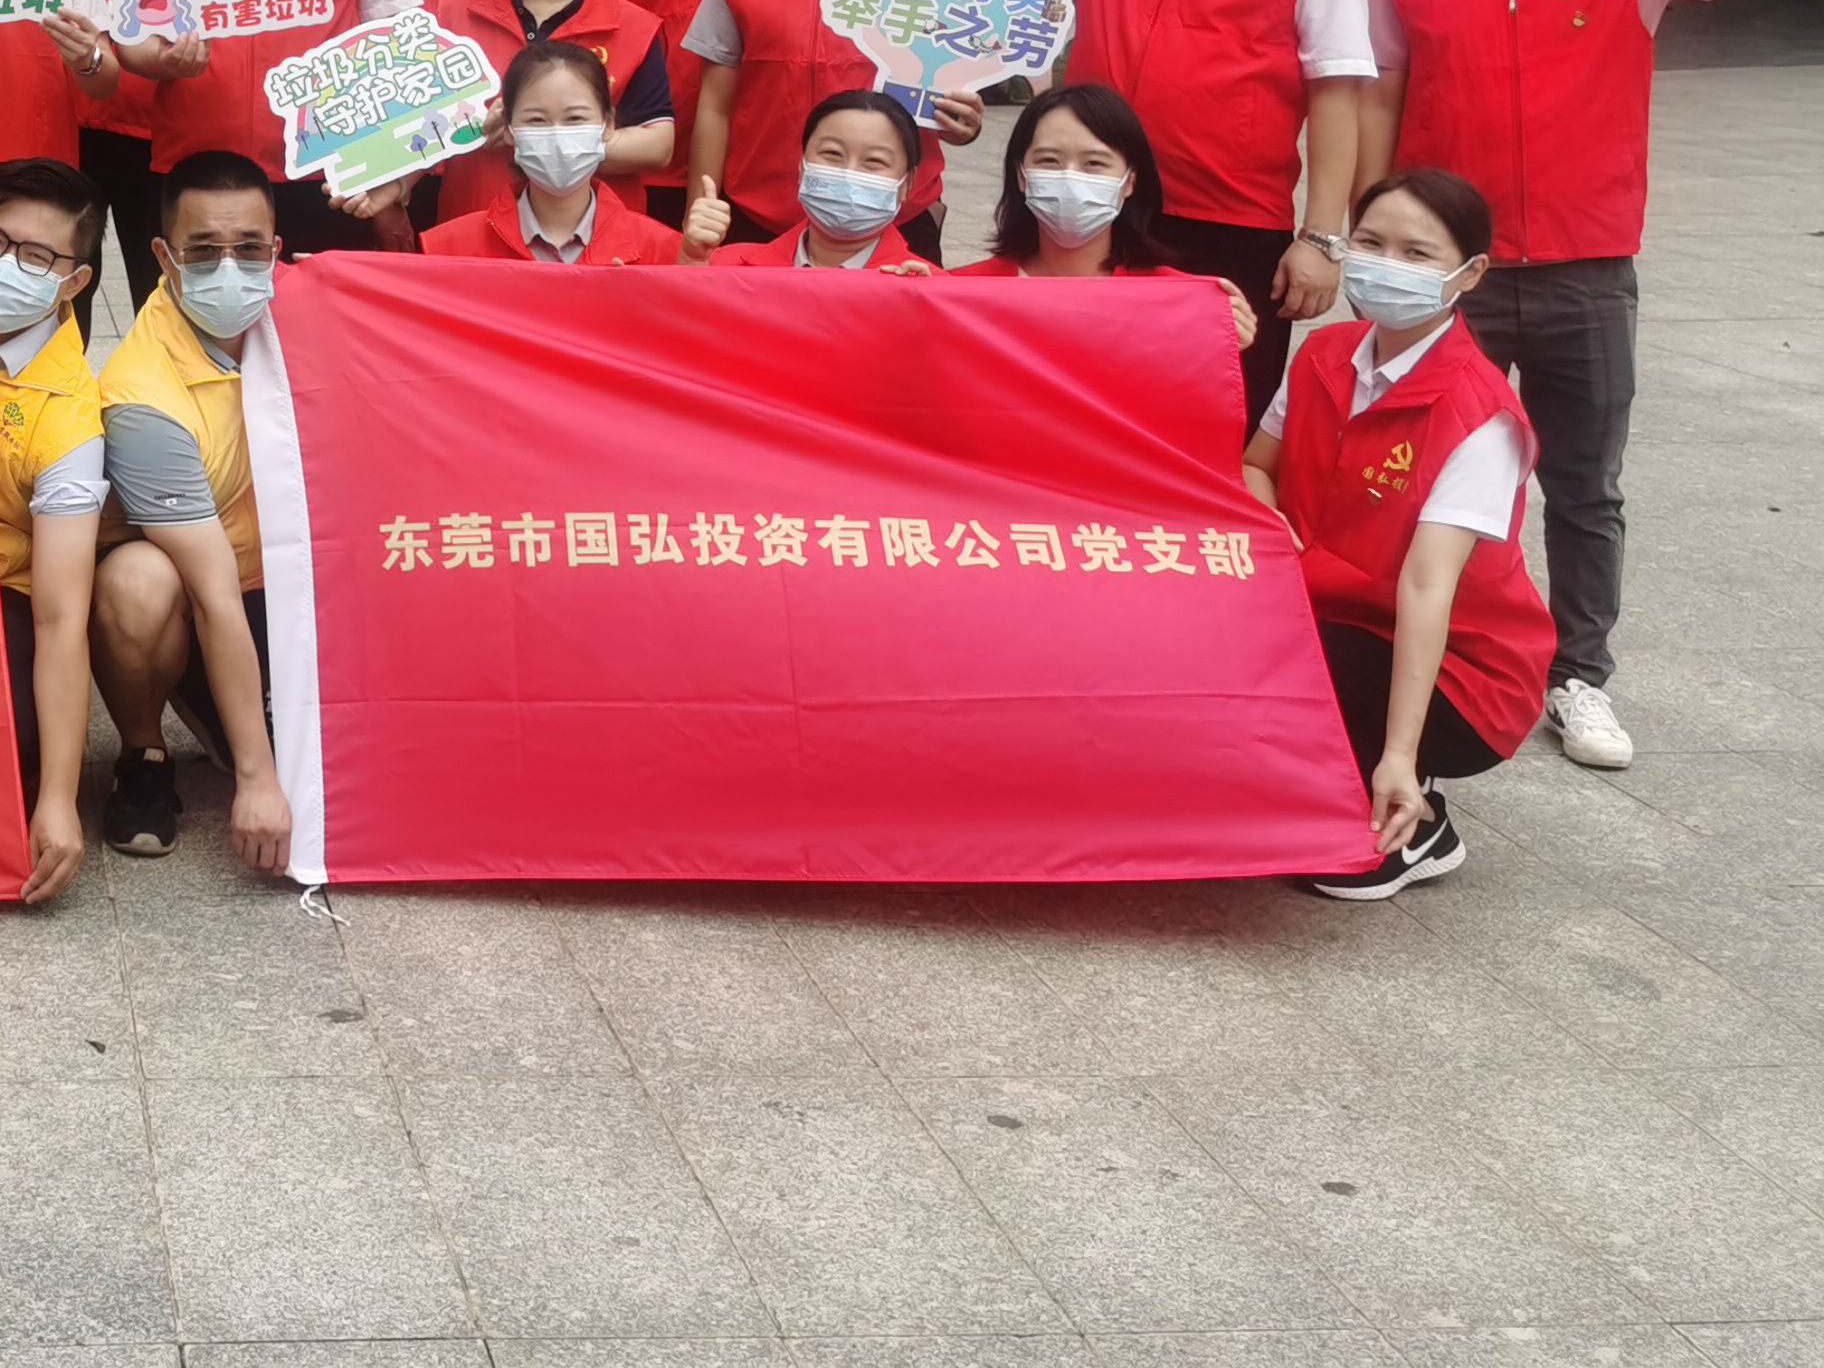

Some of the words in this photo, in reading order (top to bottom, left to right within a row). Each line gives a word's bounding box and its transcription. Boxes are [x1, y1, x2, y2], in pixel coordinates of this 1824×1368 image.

[271, 13, 439, 107] 垃圾分类
[313, 44, 482, 136] 守护家园
[378, 510, 1257, 581] 东莞市国弘投资有限公司党支部
